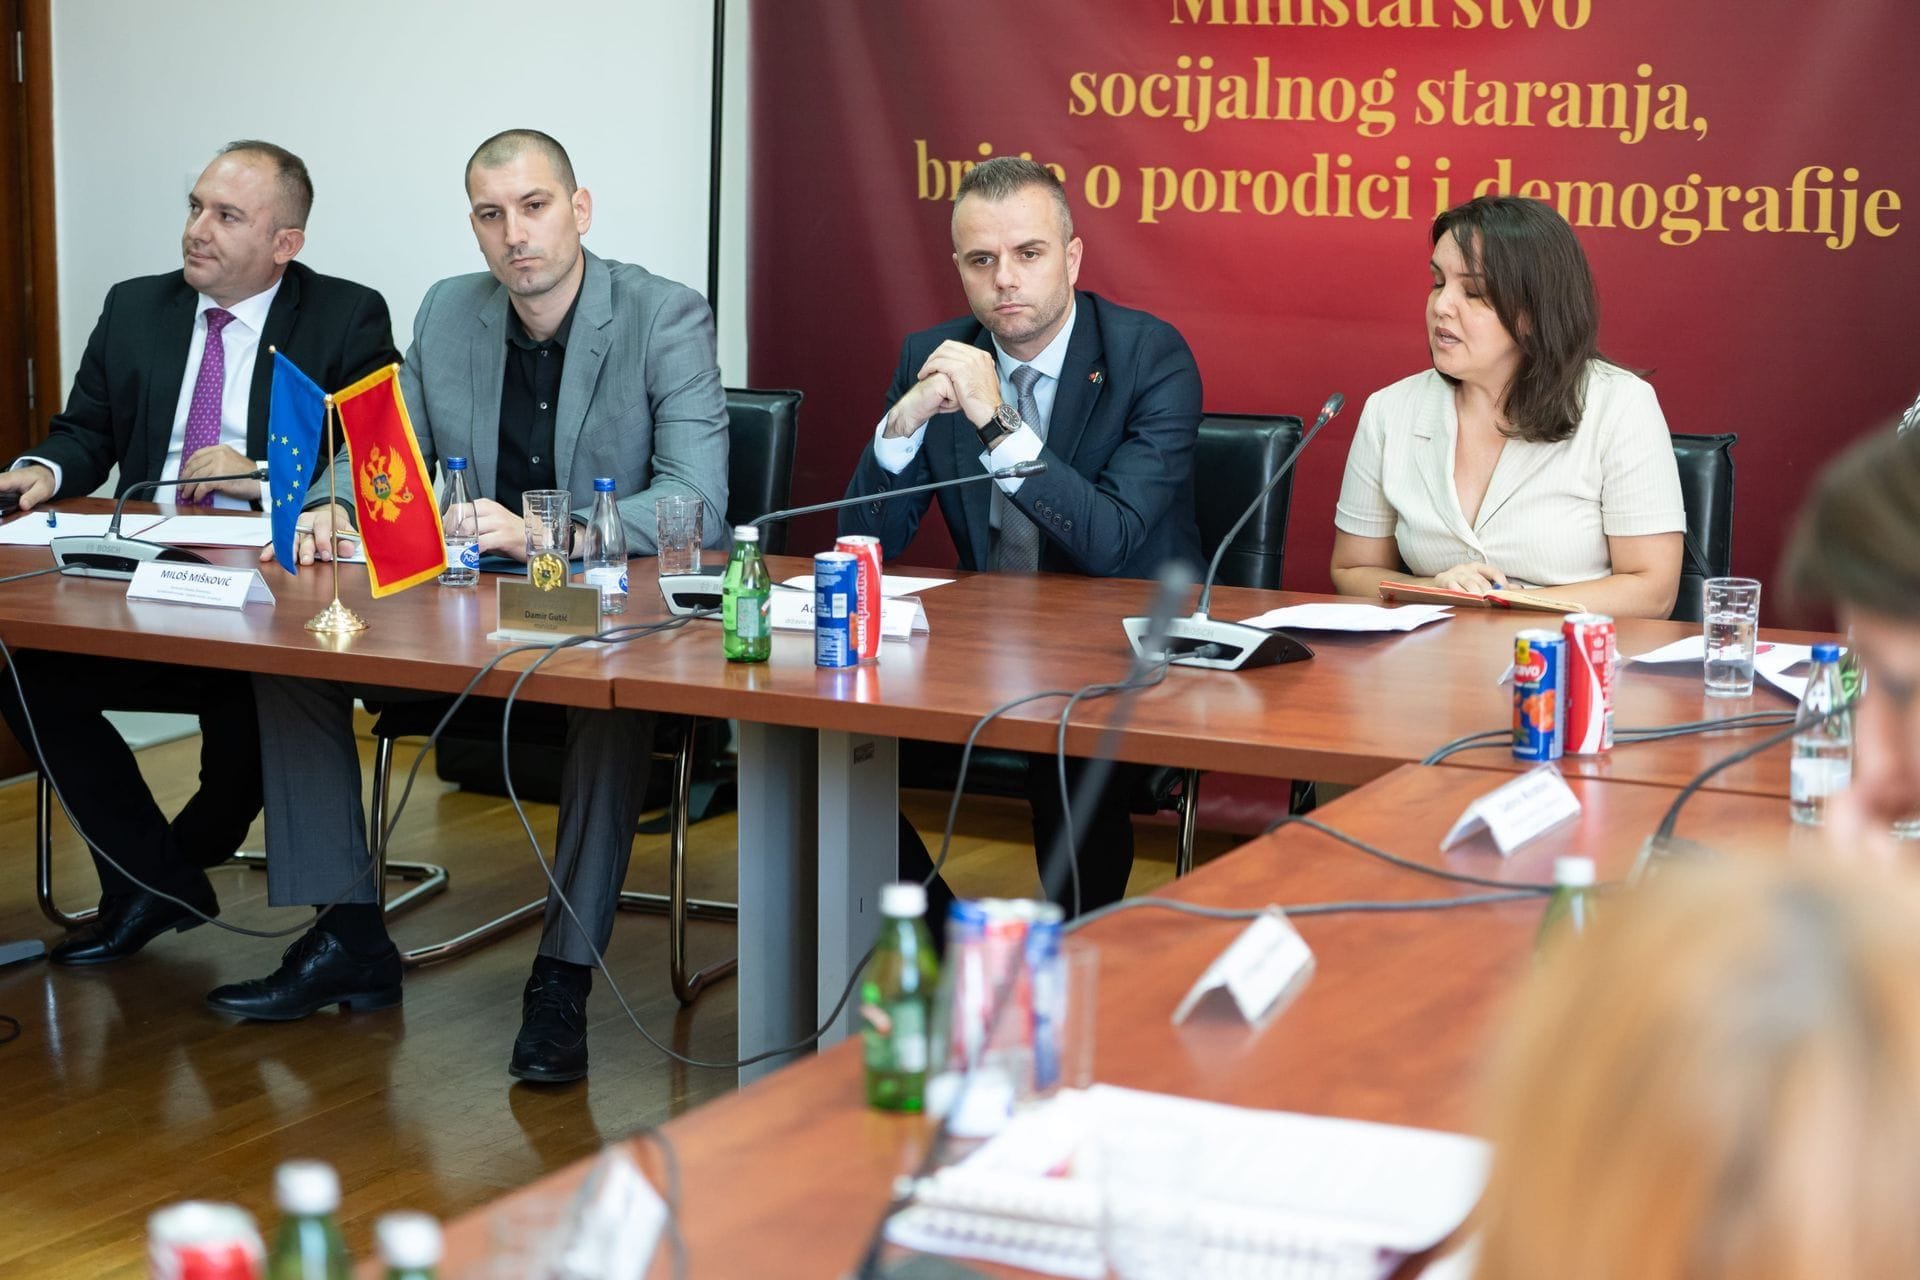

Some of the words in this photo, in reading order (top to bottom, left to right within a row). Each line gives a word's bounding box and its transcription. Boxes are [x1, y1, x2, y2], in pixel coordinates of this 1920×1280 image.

[1069, 54, 1397, 138] socijalnog
[1414, 63, 1709, 145] staranja,
[1083, 163, 1122, 210] o
[1136, 152, 1413, 224] porodici
[1431, 156, 1452, 221] i
[160, 569, 188, 581] MILOŠ
[188, 572, 232, 587] MIŠKOVIĆ
[524, 610, 547, 620] Damir
[548, 612, 568, 622] Gutić
